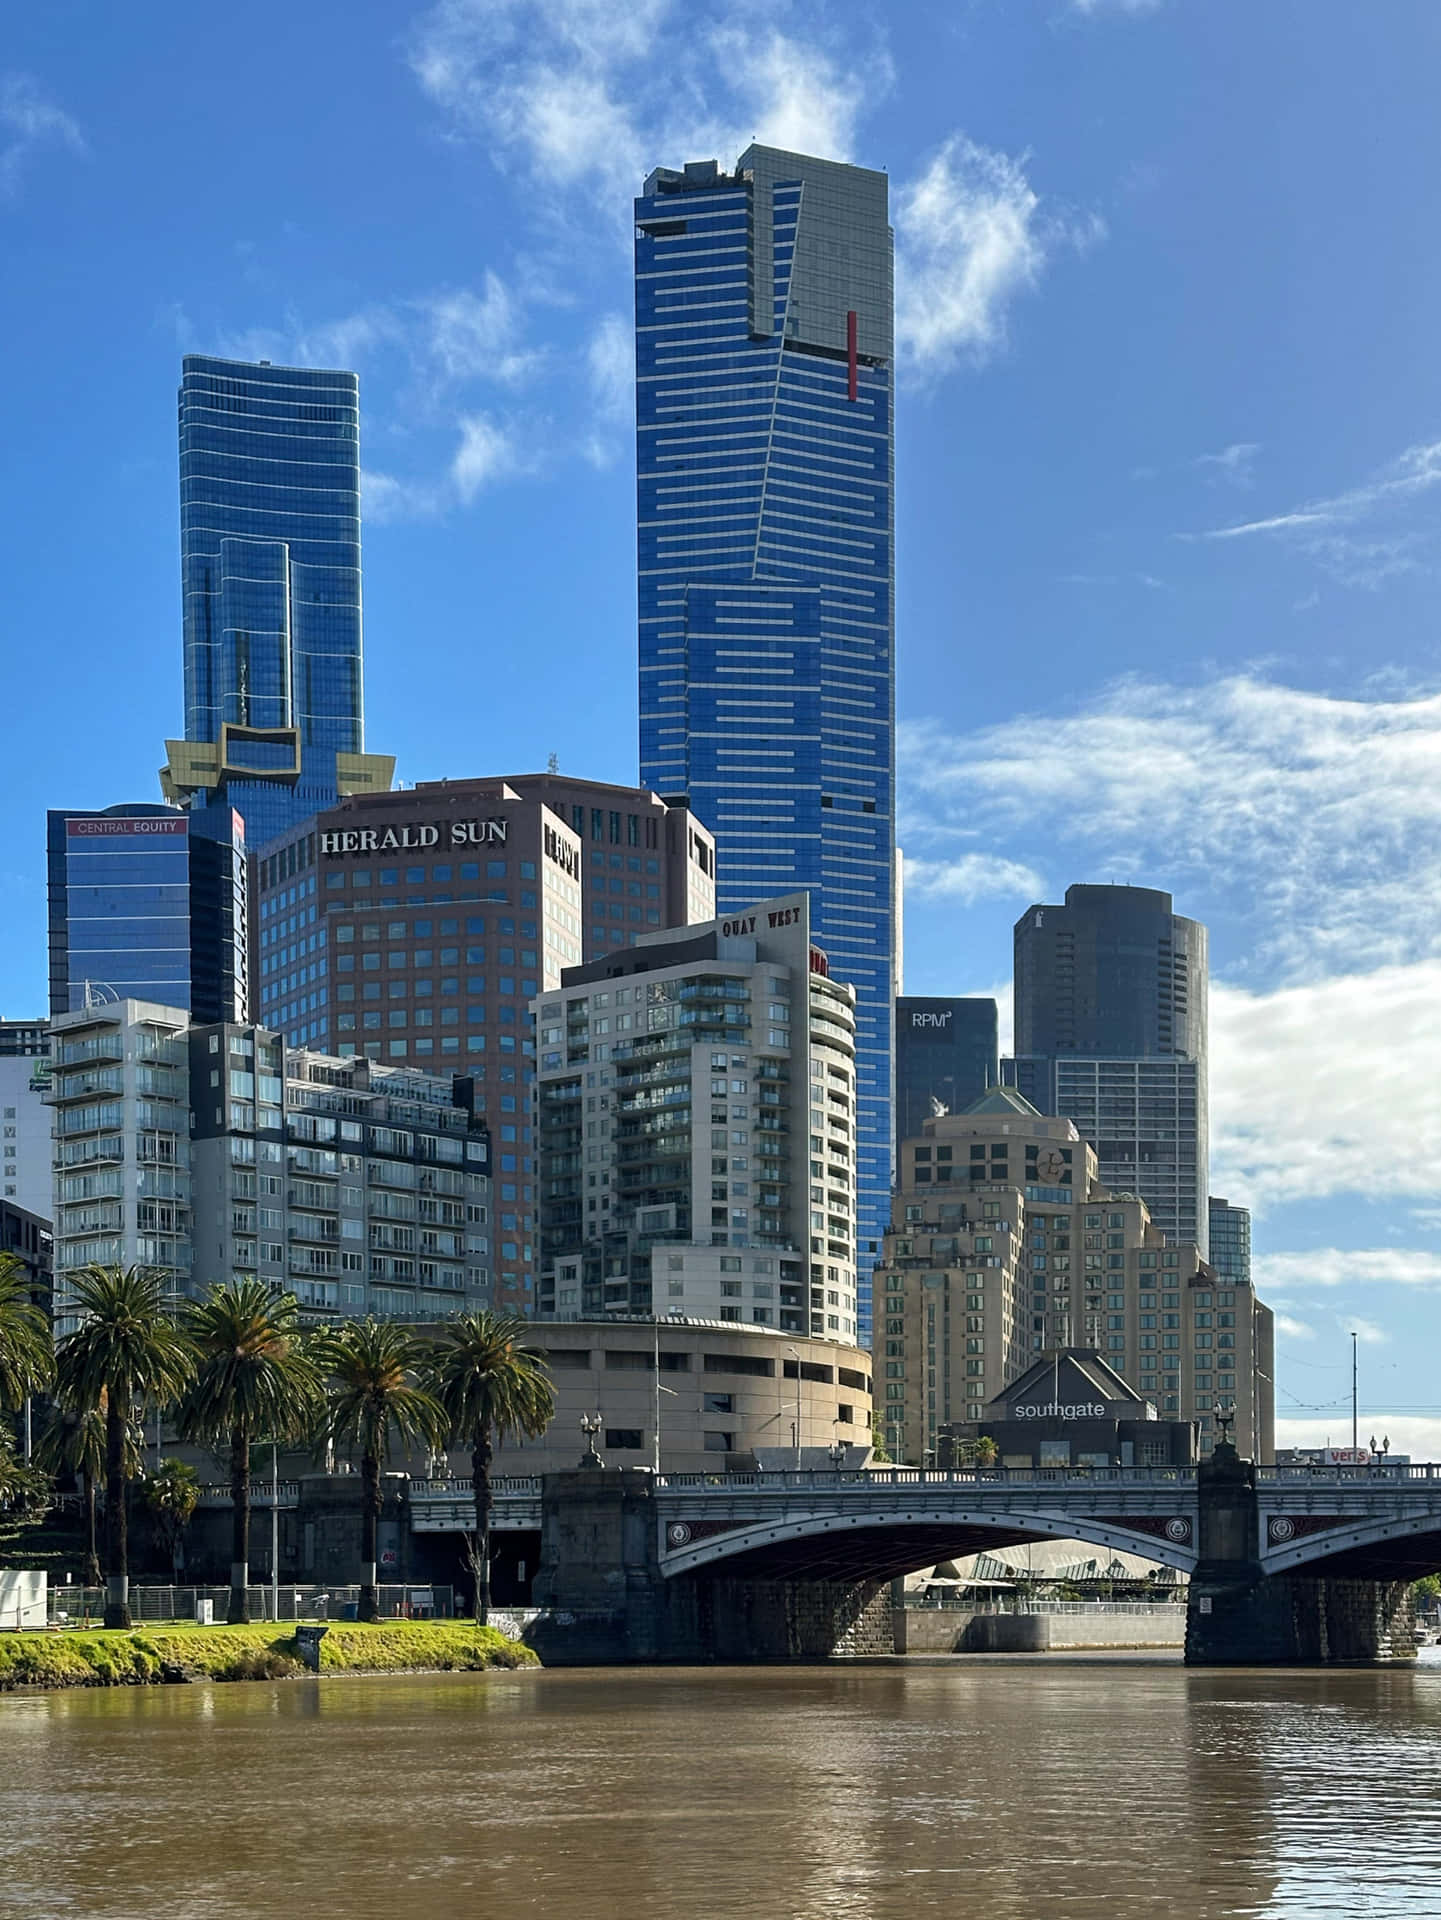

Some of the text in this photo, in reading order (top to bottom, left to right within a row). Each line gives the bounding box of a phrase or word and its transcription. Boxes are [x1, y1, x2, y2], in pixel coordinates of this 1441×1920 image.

[78, 822, 176, 833] CENTRAL EQUITY
[320, 821, 508, 853] HERALD SUN
[723, 907, 800, 937] QUAY WEST
[1015, 1402, 1105, 1420] southgate
